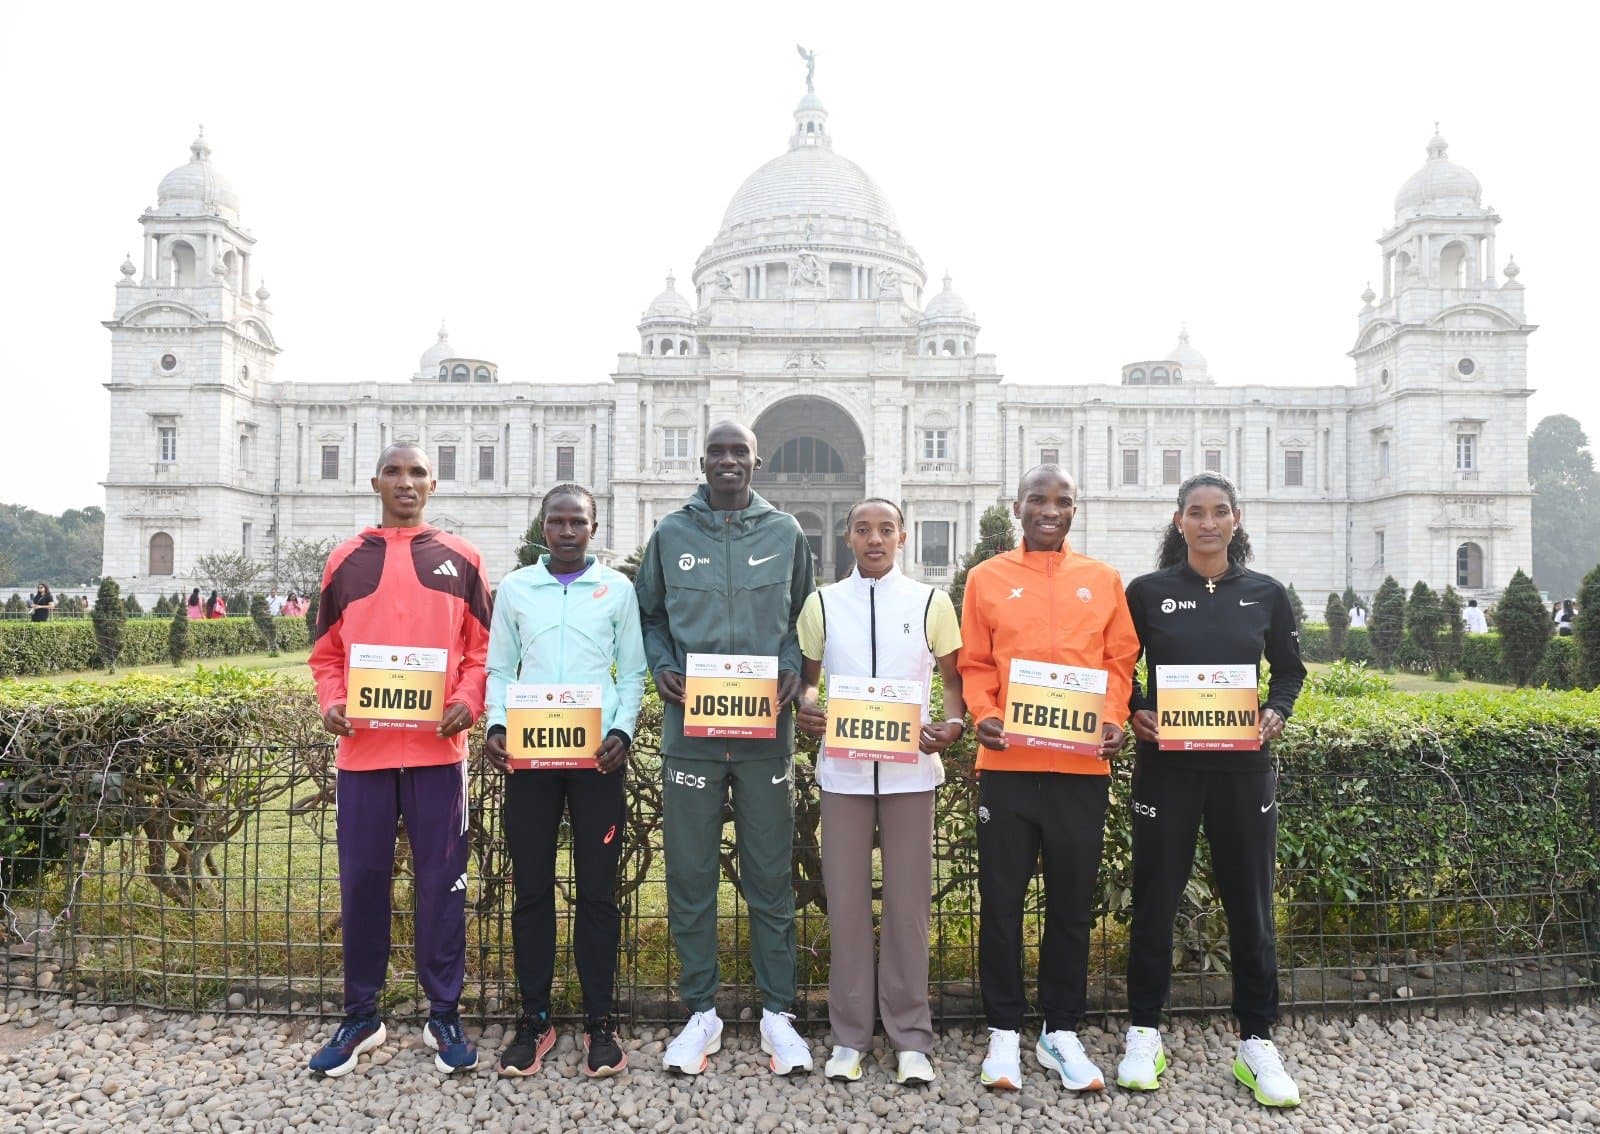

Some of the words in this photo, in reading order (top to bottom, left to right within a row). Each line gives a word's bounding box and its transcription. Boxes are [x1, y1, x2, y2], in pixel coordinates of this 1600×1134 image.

[1178, 600, 1196, 609] NN
[360, 687, 432, 710] SIMBU
[690, 695, 771, 717] JOSHUA
[1012, 702, 1097, 733] TEBELLO
[1161, 710, 1256, 727] AZIMERAW
[523, 727, 585, 748] KEINO
[836, 717, 911, 742] KEBEDE
[668, 768, 706, 788] INEOS
